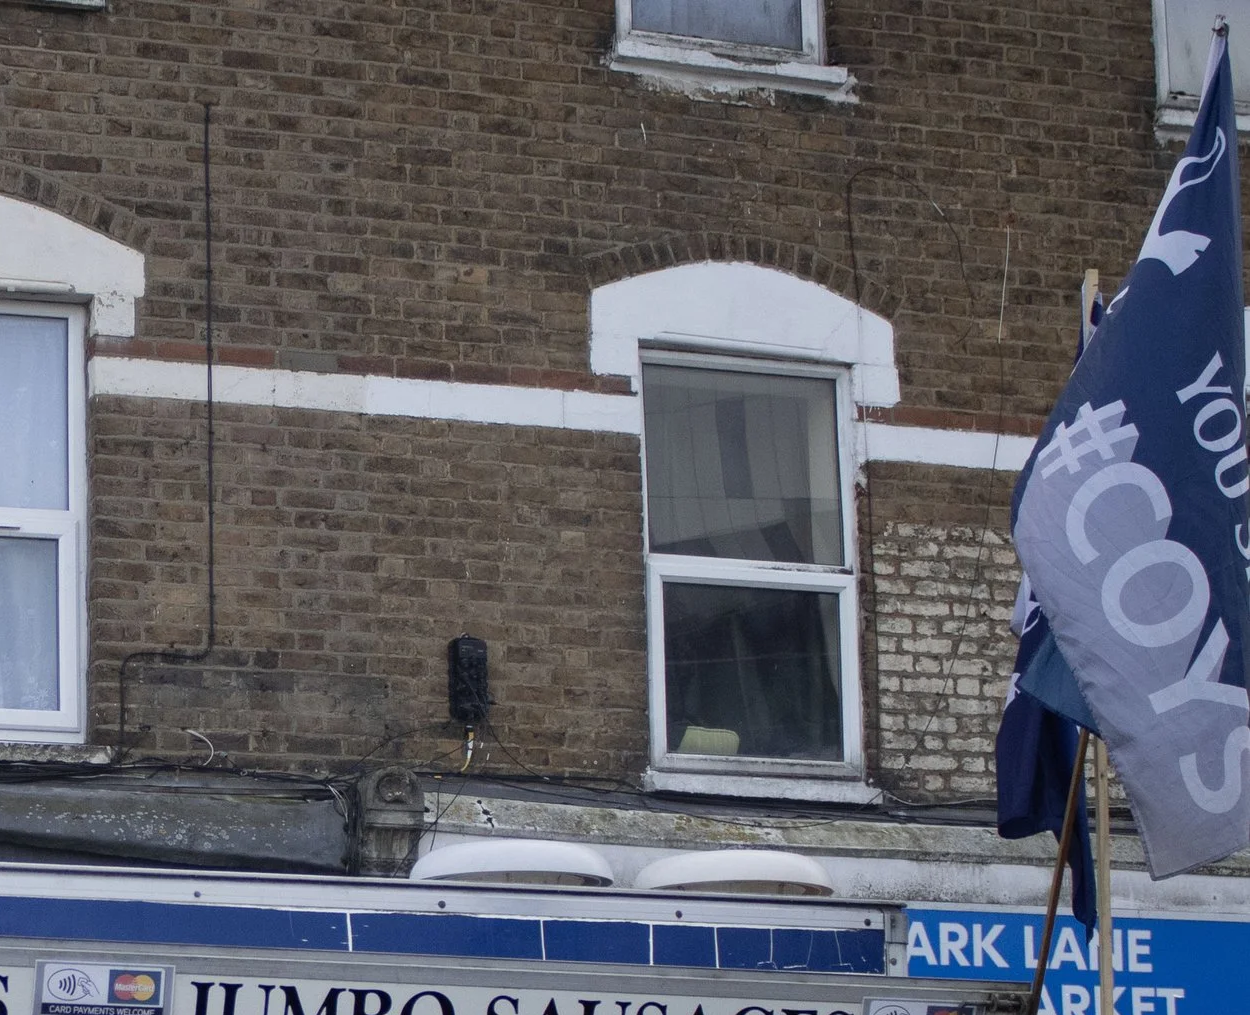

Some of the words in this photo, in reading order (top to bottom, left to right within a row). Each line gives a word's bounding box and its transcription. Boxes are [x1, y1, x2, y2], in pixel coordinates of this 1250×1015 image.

[907, 922, 1009, 968] ARK
[1024, 926, 1153, 973] LANE
[114, 983, 155, 993] MasterCard
[49, 1005, 72, 1014] CARD
[73, 1006, 115, 1015] PAYMENTS
